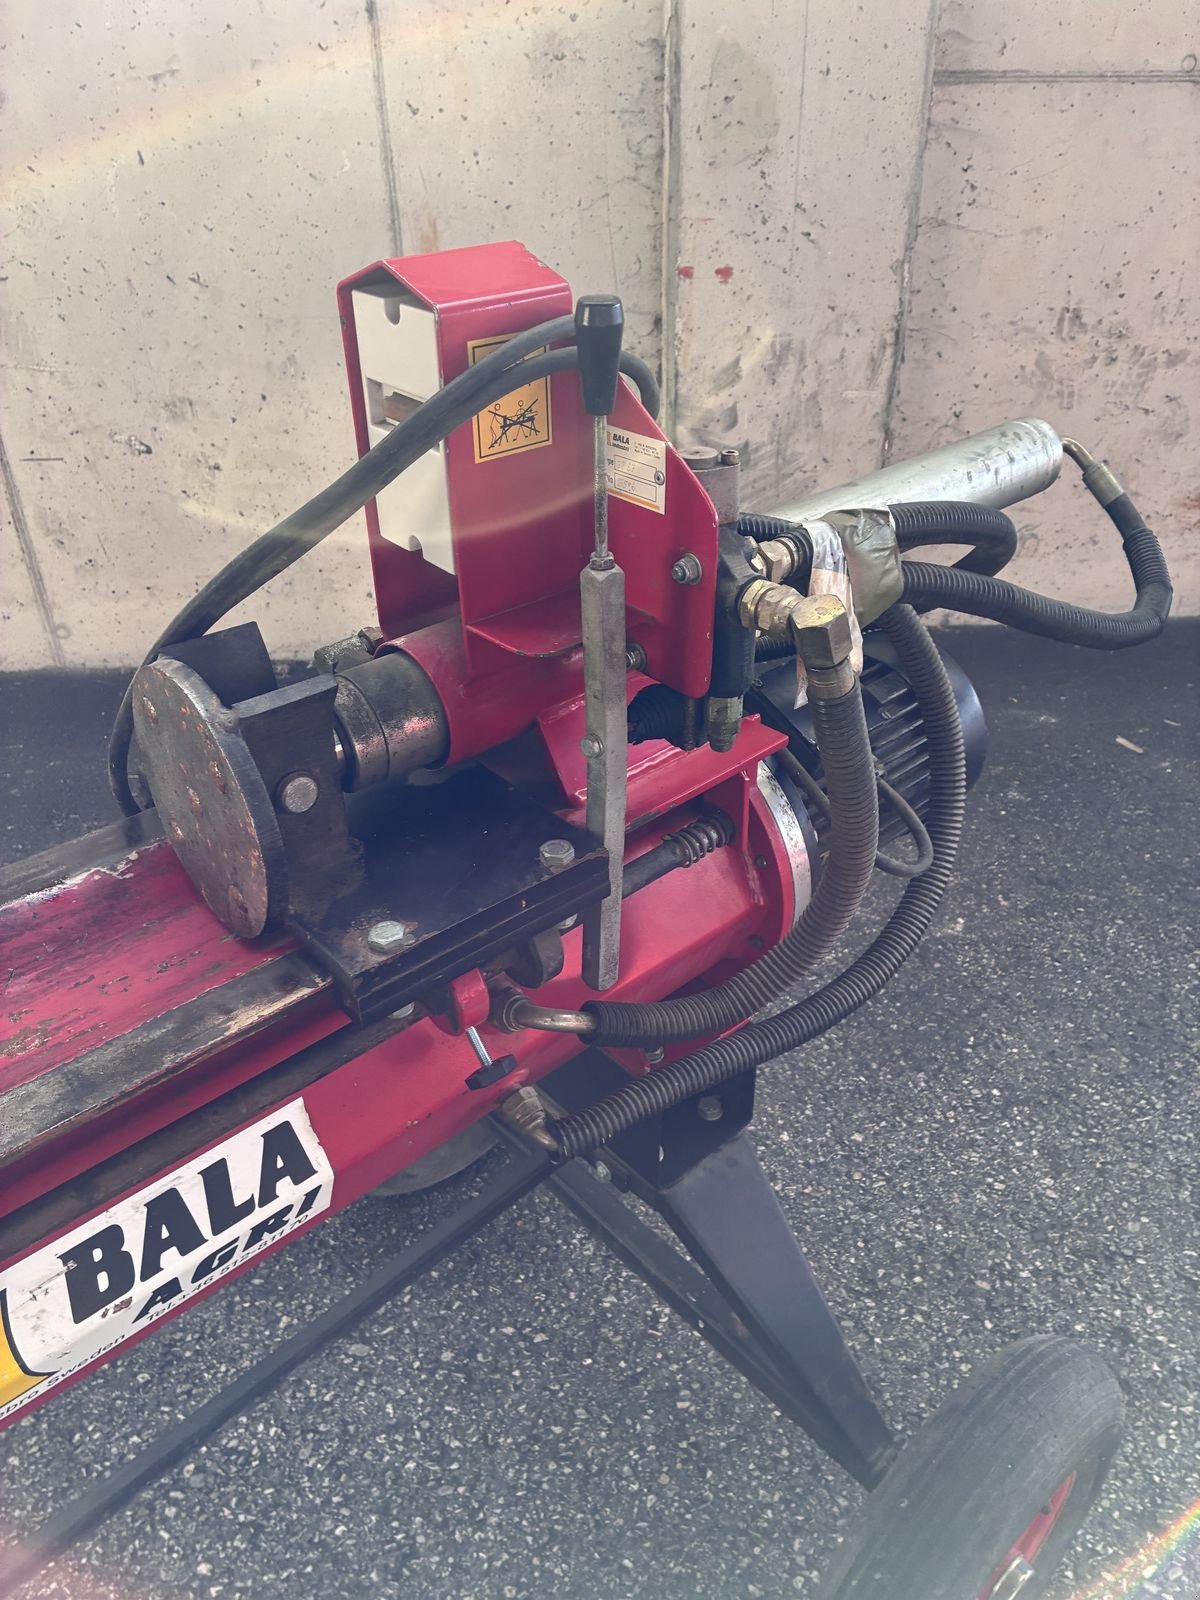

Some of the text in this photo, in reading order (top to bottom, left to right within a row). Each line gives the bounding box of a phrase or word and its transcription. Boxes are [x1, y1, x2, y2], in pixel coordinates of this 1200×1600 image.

[612, 433, 630, 446] BALA
[47, 1334, 126, 1387] Sweden
[146, 1302, 176, 1321] Tel.
[179, 1276, 214, 1300] +46
[219, 1214, 309, 1276] 512-81170
[57, 1120, 319, 1325] BALA
[131, 1184, 323, 1324] AGRI
